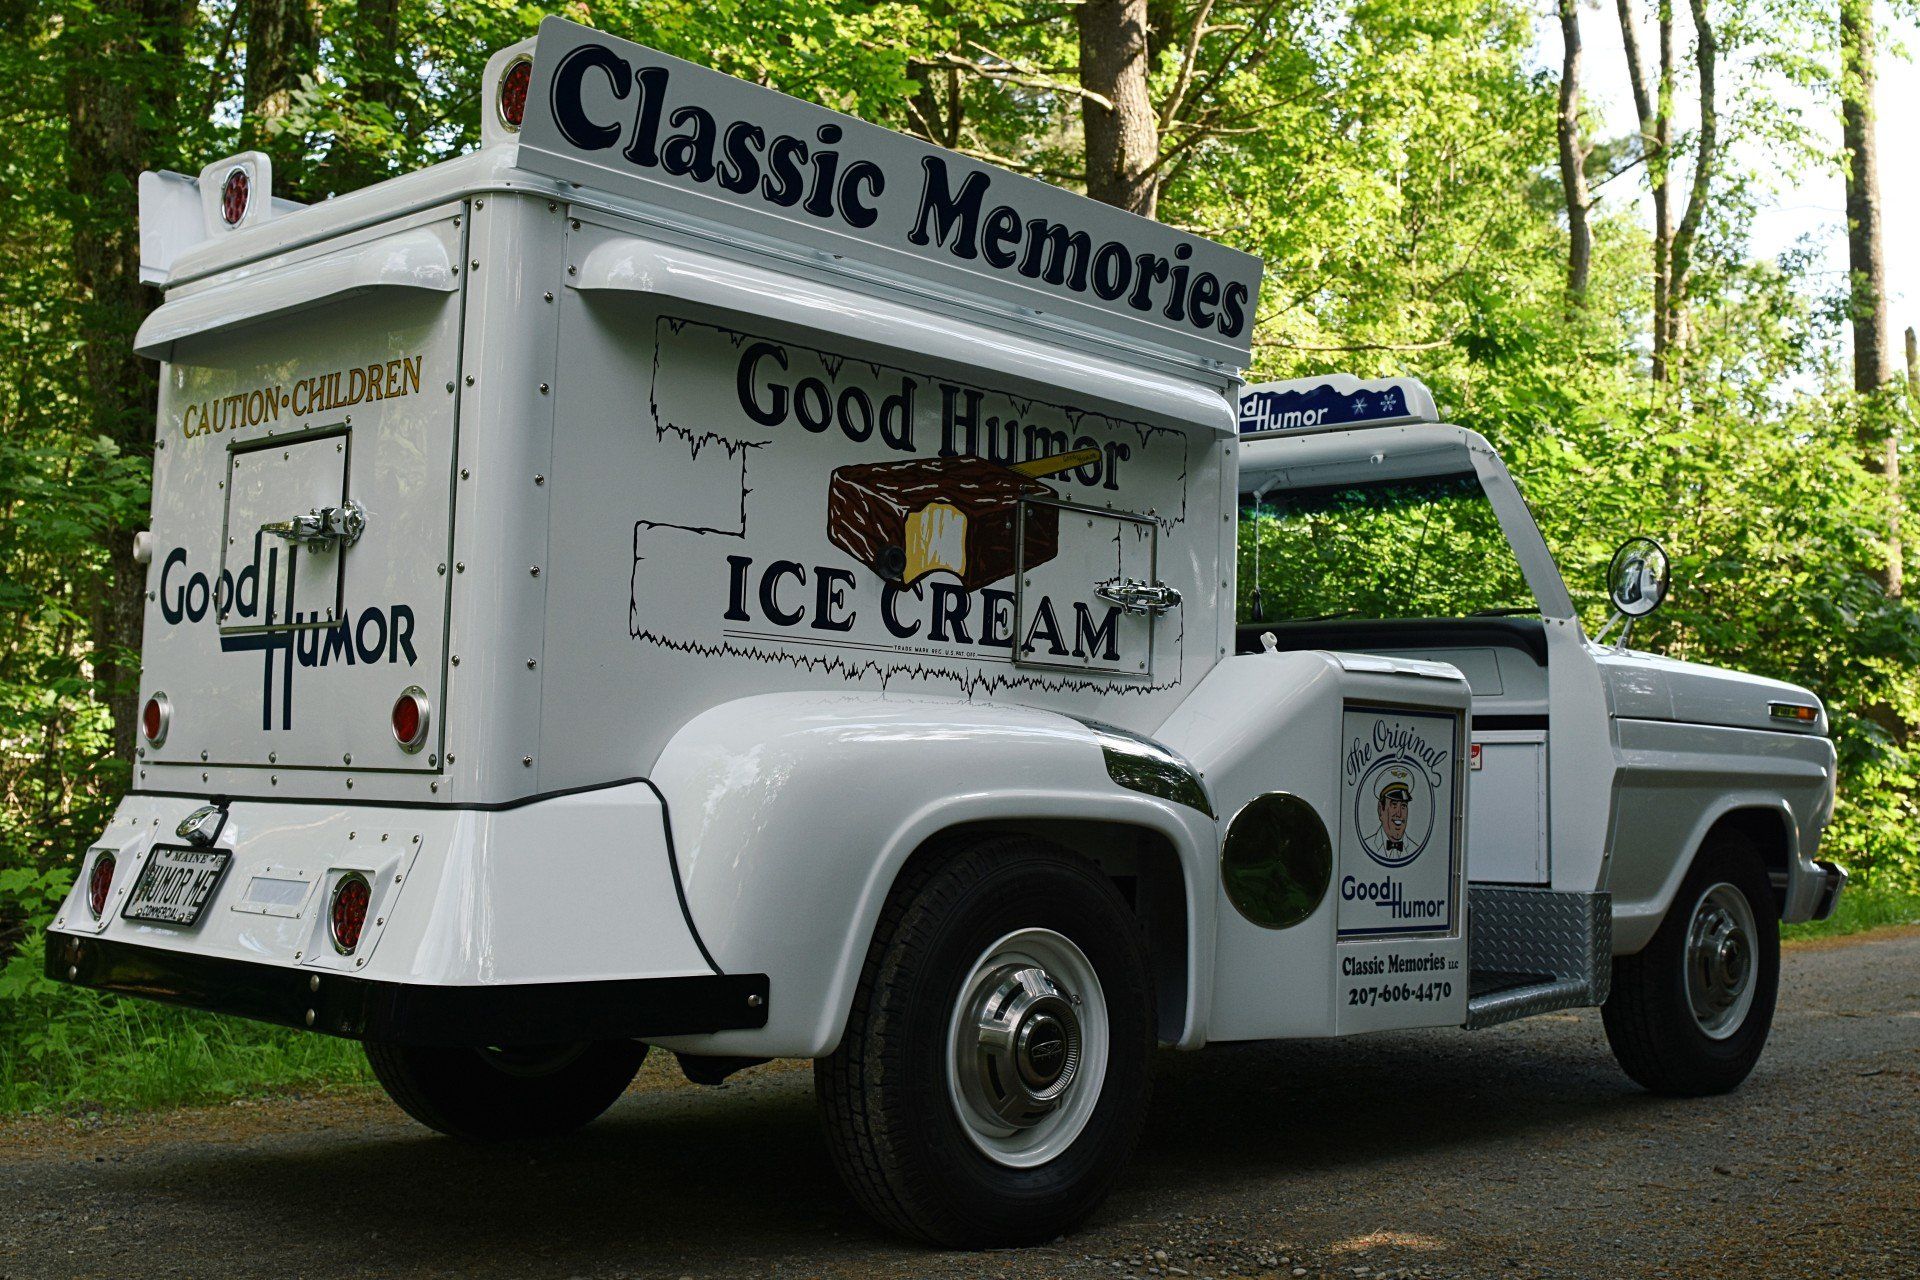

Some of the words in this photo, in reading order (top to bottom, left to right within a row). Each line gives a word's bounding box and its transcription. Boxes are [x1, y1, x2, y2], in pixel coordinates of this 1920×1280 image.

[550, 44, 884, 228] Classic
[907, 155, 1248, 338] Memories
[736, 343, 918, 453] Good
[938, 384, 1130, 490] Humor
[1240, 399, 1328, 431] Humor
[160, 527, 263, 625] Good
[723, 555, 857, 631] ICE
[880, 581, 1122, 662] CREAM
[1346, 737, 1372, 786] The
[1373, 720, 1447, 787] Original
[172, 852, 209, 864] MAINE
[138, 865, 194, 906] HUMOR
[183, 869, 219, 908] ME
[1341, 875, 1390, 900] Good
[1375, 882, 1445, 918] Humor
[141, 904, 179, 919] COMMERCIAL
[1342, 955, 1385, 976] Classic
[1388, 953, 1446, 974] Memories
[1448, 960, 1459, 970] LLC
[1348, 982, 1452, 1007] 207-606-4470
